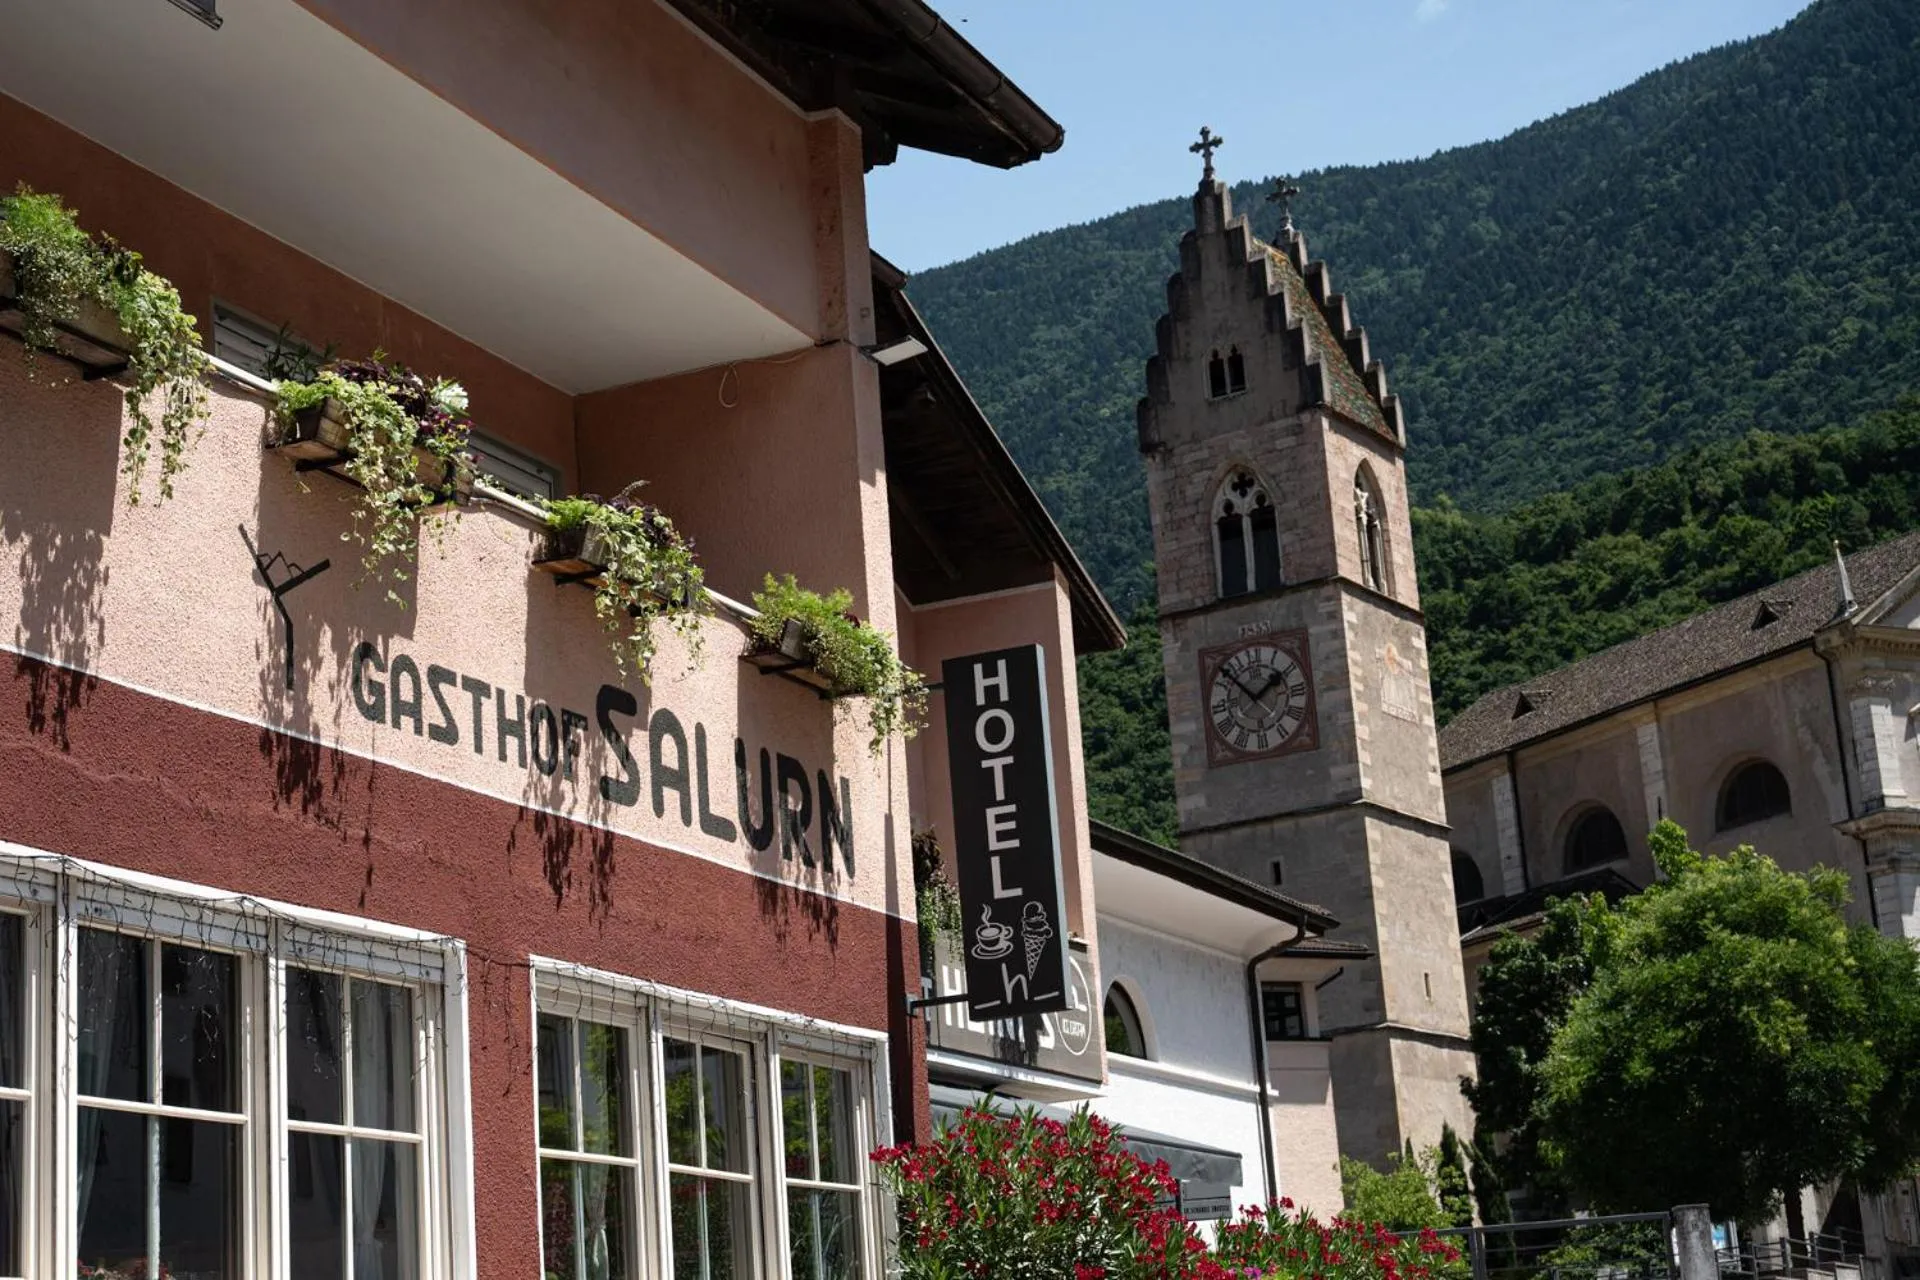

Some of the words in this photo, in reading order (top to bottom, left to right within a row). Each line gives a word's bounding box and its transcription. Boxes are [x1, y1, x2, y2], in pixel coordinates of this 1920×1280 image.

[352, 642, 588, 782] GASTHOF
[596, 684, 856, 879] SALURN
[973, 658, 1023, 900] HOTEL
